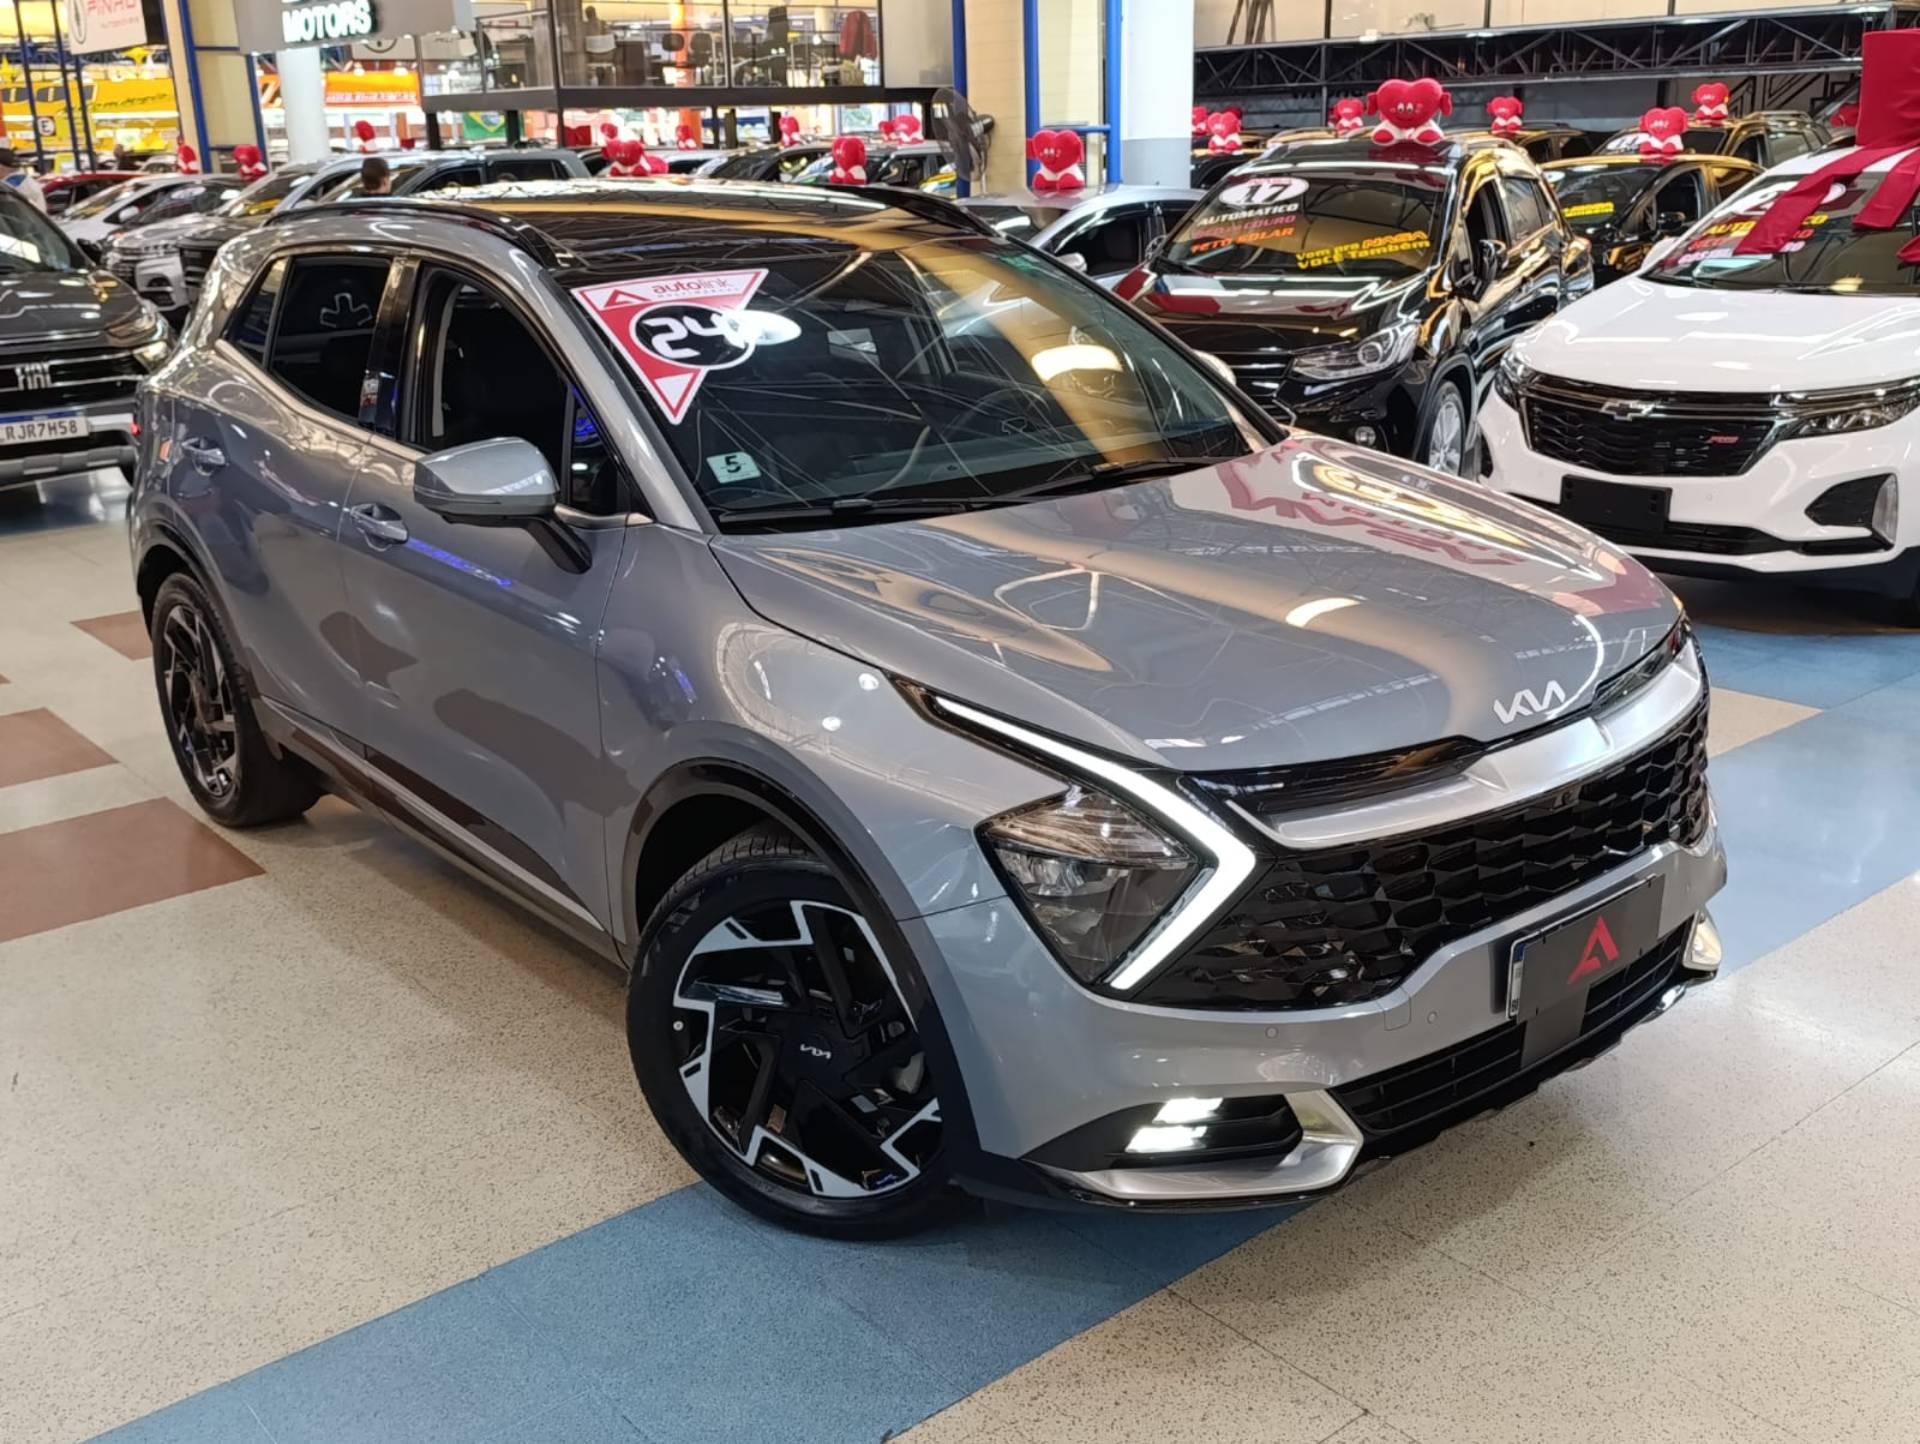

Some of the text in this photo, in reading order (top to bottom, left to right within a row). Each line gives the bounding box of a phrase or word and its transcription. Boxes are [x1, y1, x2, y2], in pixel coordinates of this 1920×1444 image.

[282, 0, 372, 42] MOTORS
[41, 120, 51, 133] E
[1244, 183, 1292, 203] 17
[1236, 227, 1295, 245] SOLAR
[652, 278, 729, 294] autolink
[642, 311, 747, 360] 24
[6, 419, 78, 441] RJR7H58
[724, 455, 741, 474] 5
[1493, 679, 1566, 724] KIA
